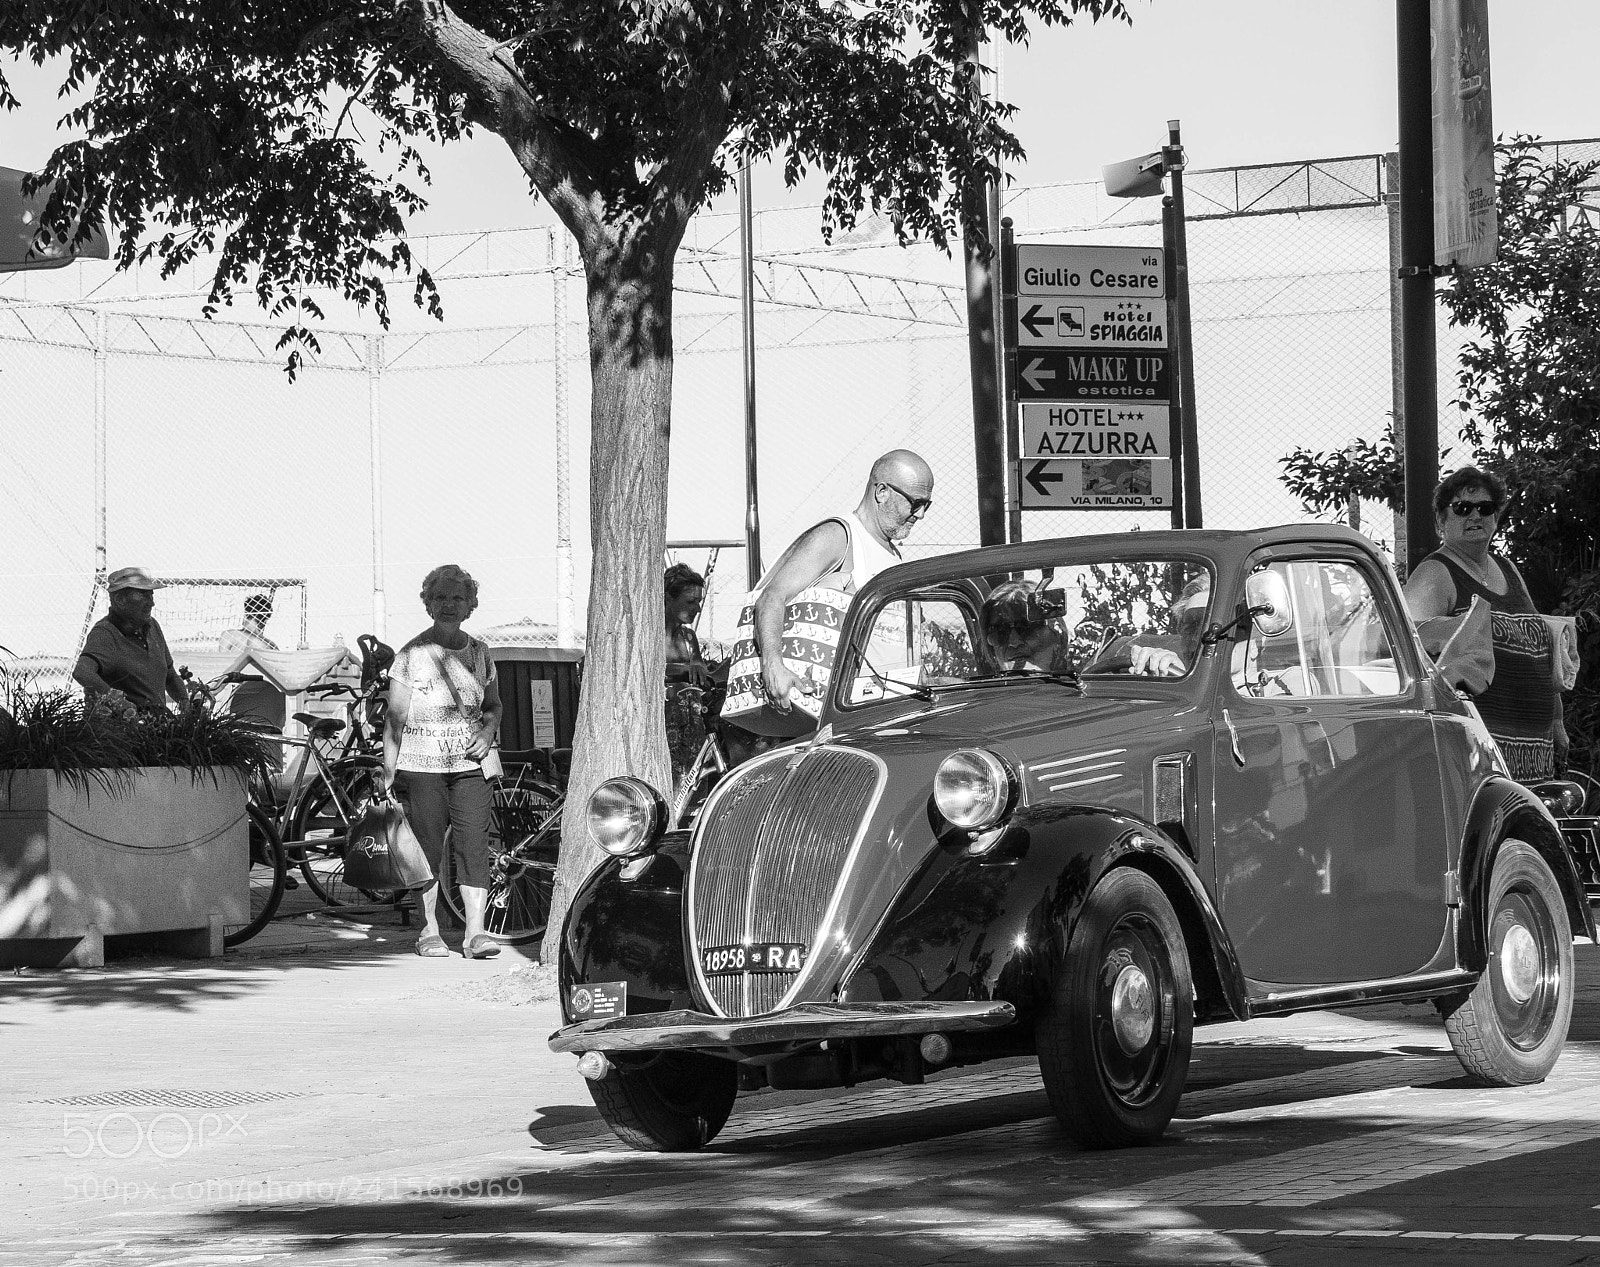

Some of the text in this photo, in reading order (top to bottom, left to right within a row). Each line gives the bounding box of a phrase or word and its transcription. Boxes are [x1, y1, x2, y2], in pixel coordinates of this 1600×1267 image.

[1142, 256, 1158, 266] via
[1024, 268, 1159, 288] Giulio Cesare
[1104, 311, 1152, 322] Hotel
[1090, 324, 1163, 342] SPIAGGIA
[1067, 356, 1163, 382] MAKE UP
[1078, 386, 1155, 396] estetica
[1049, 408, 1119, 426] HOTEL
[1037, 432, 1158, 454] AZZURRA
[1071, 496, 1163, 506] VIA MILANO, 10
[705, 946, 801, 971] 18958 RA
